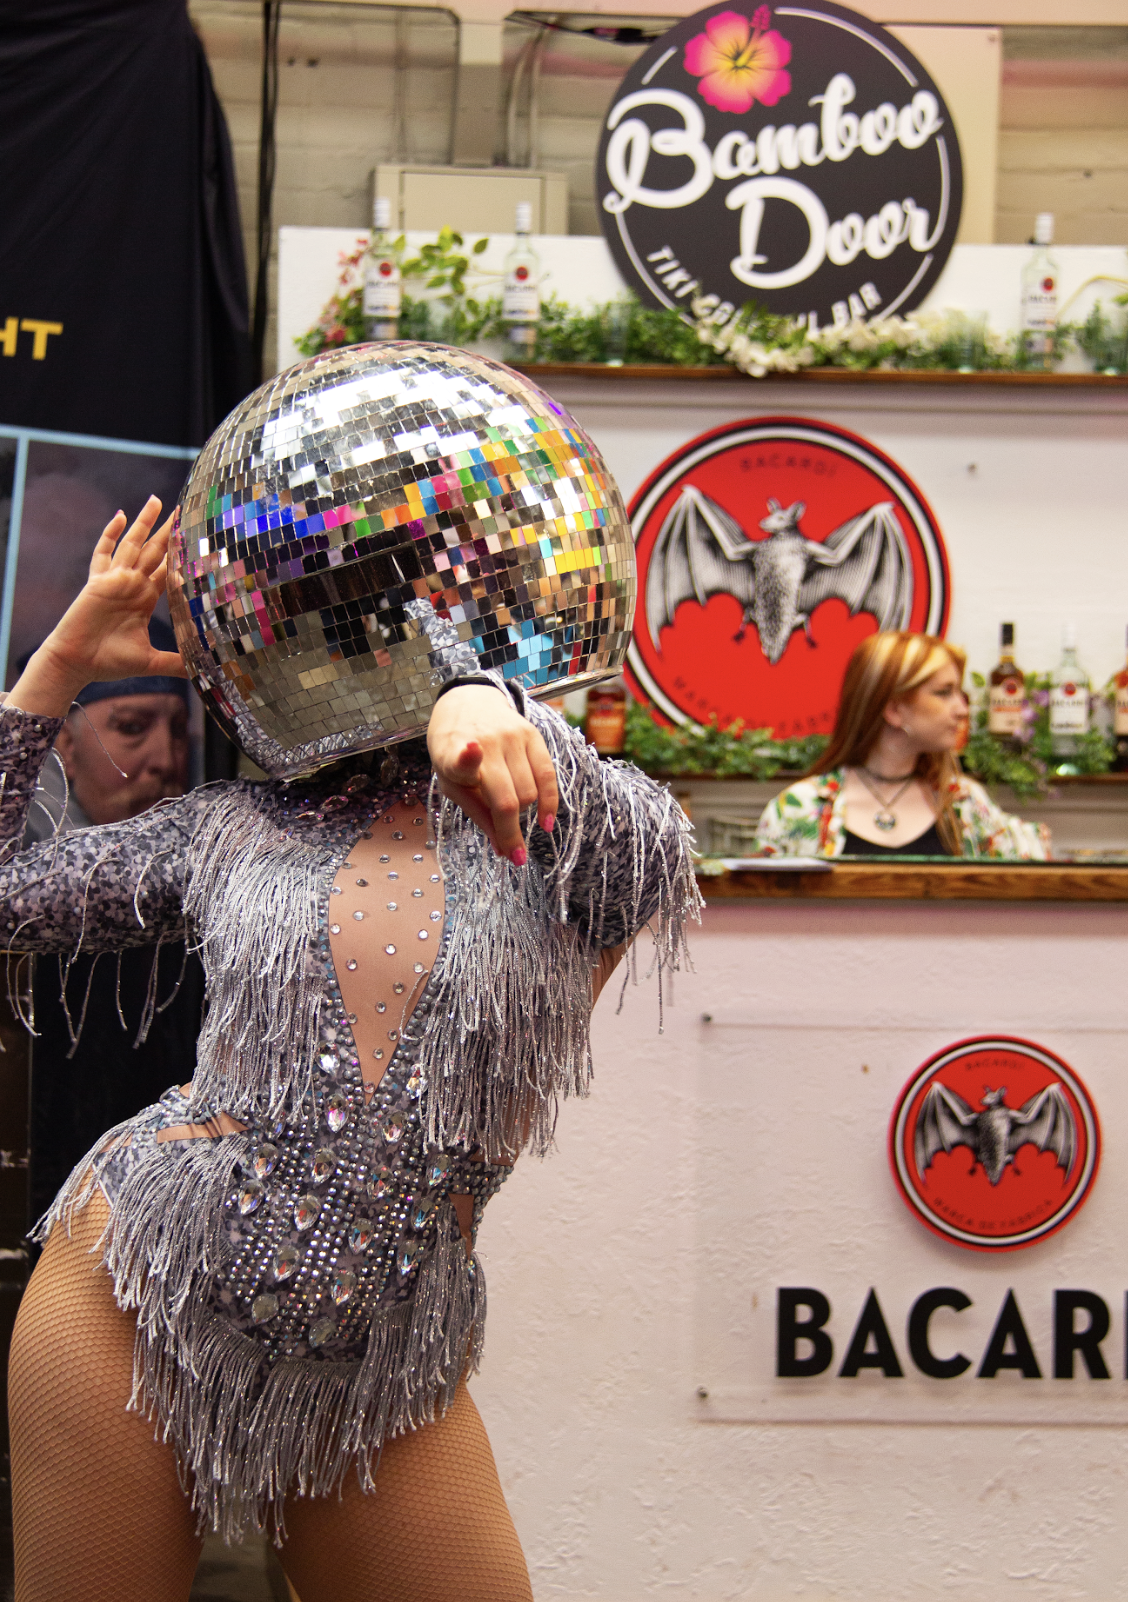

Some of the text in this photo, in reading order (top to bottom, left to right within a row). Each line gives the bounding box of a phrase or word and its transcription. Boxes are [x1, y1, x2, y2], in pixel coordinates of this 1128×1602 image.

[603, 73, 944, 214] Bamboo
[724, 176, 934, 290] Door
[646, 245, 699, 299] TIKI
[831, 281, 883, 328] BAR
[775, 1286, 1128, 1380] BACAR
